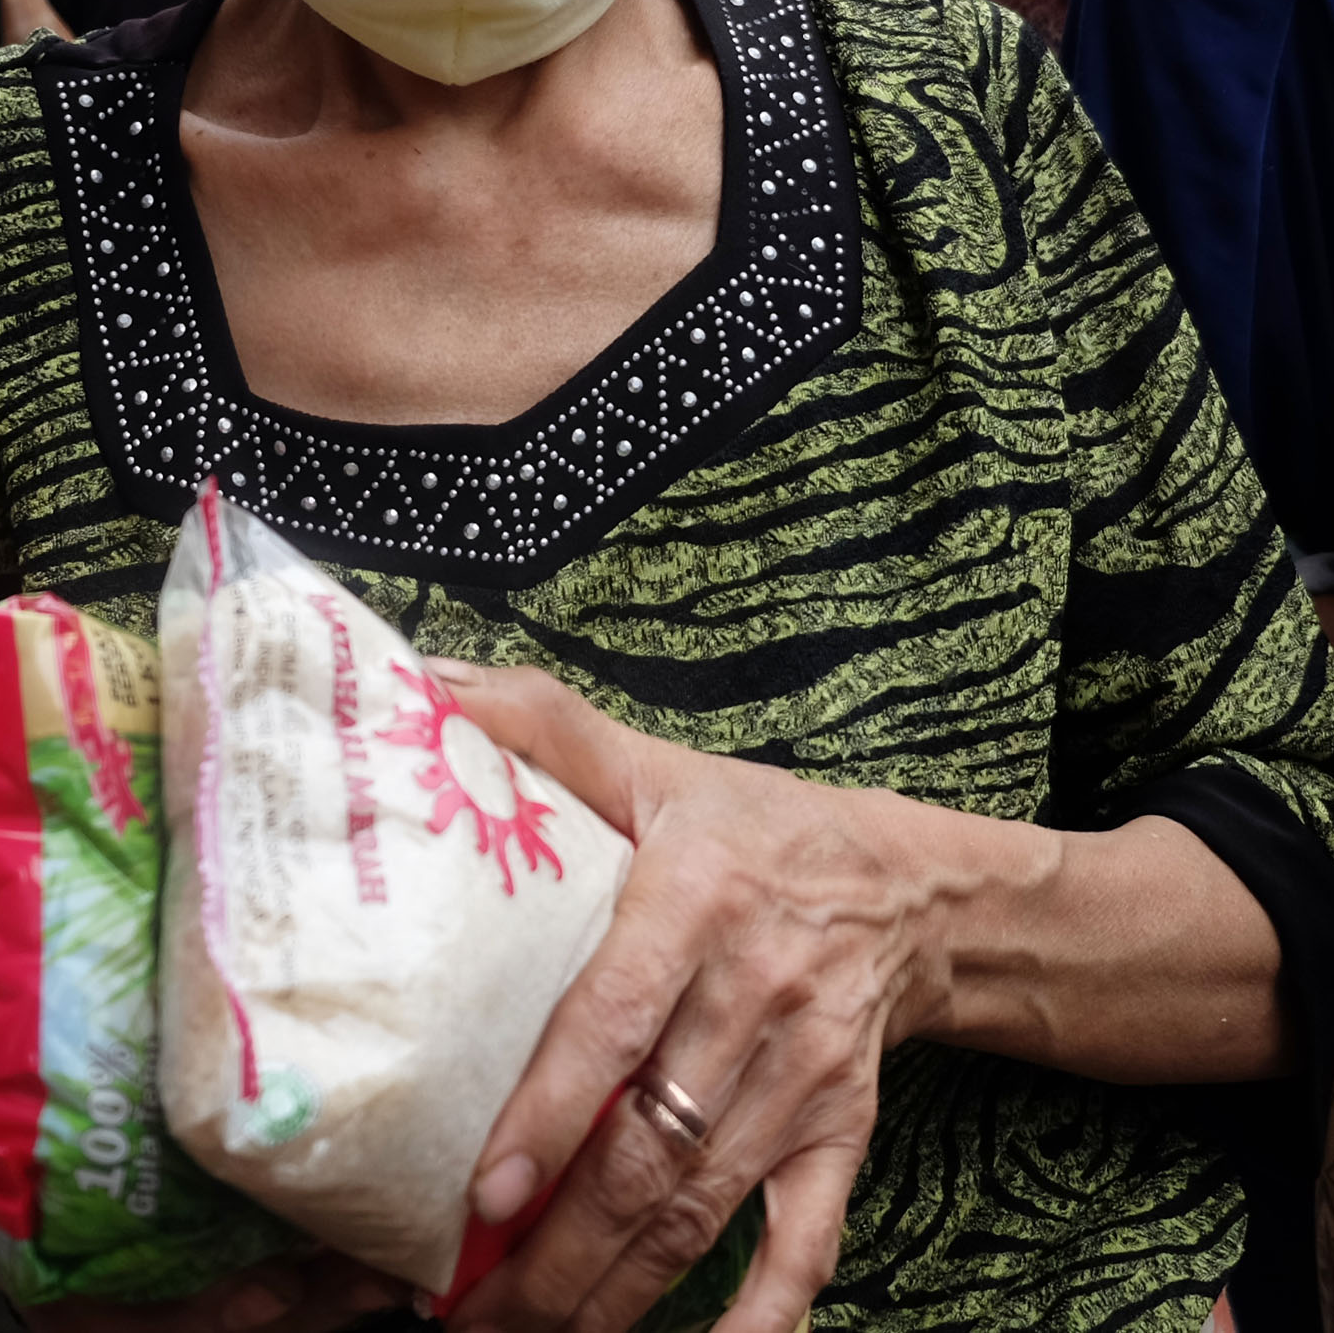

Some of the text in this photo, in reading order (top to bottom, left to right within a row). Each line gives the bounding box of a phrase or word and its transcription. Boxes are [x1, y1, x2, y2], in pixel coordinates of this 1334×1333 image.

[306, 592, 391, 909] MATAHARI MERAH
[72, 1040, 141, 1201] 100%
[124, 1135, 161, 1217] Gula
